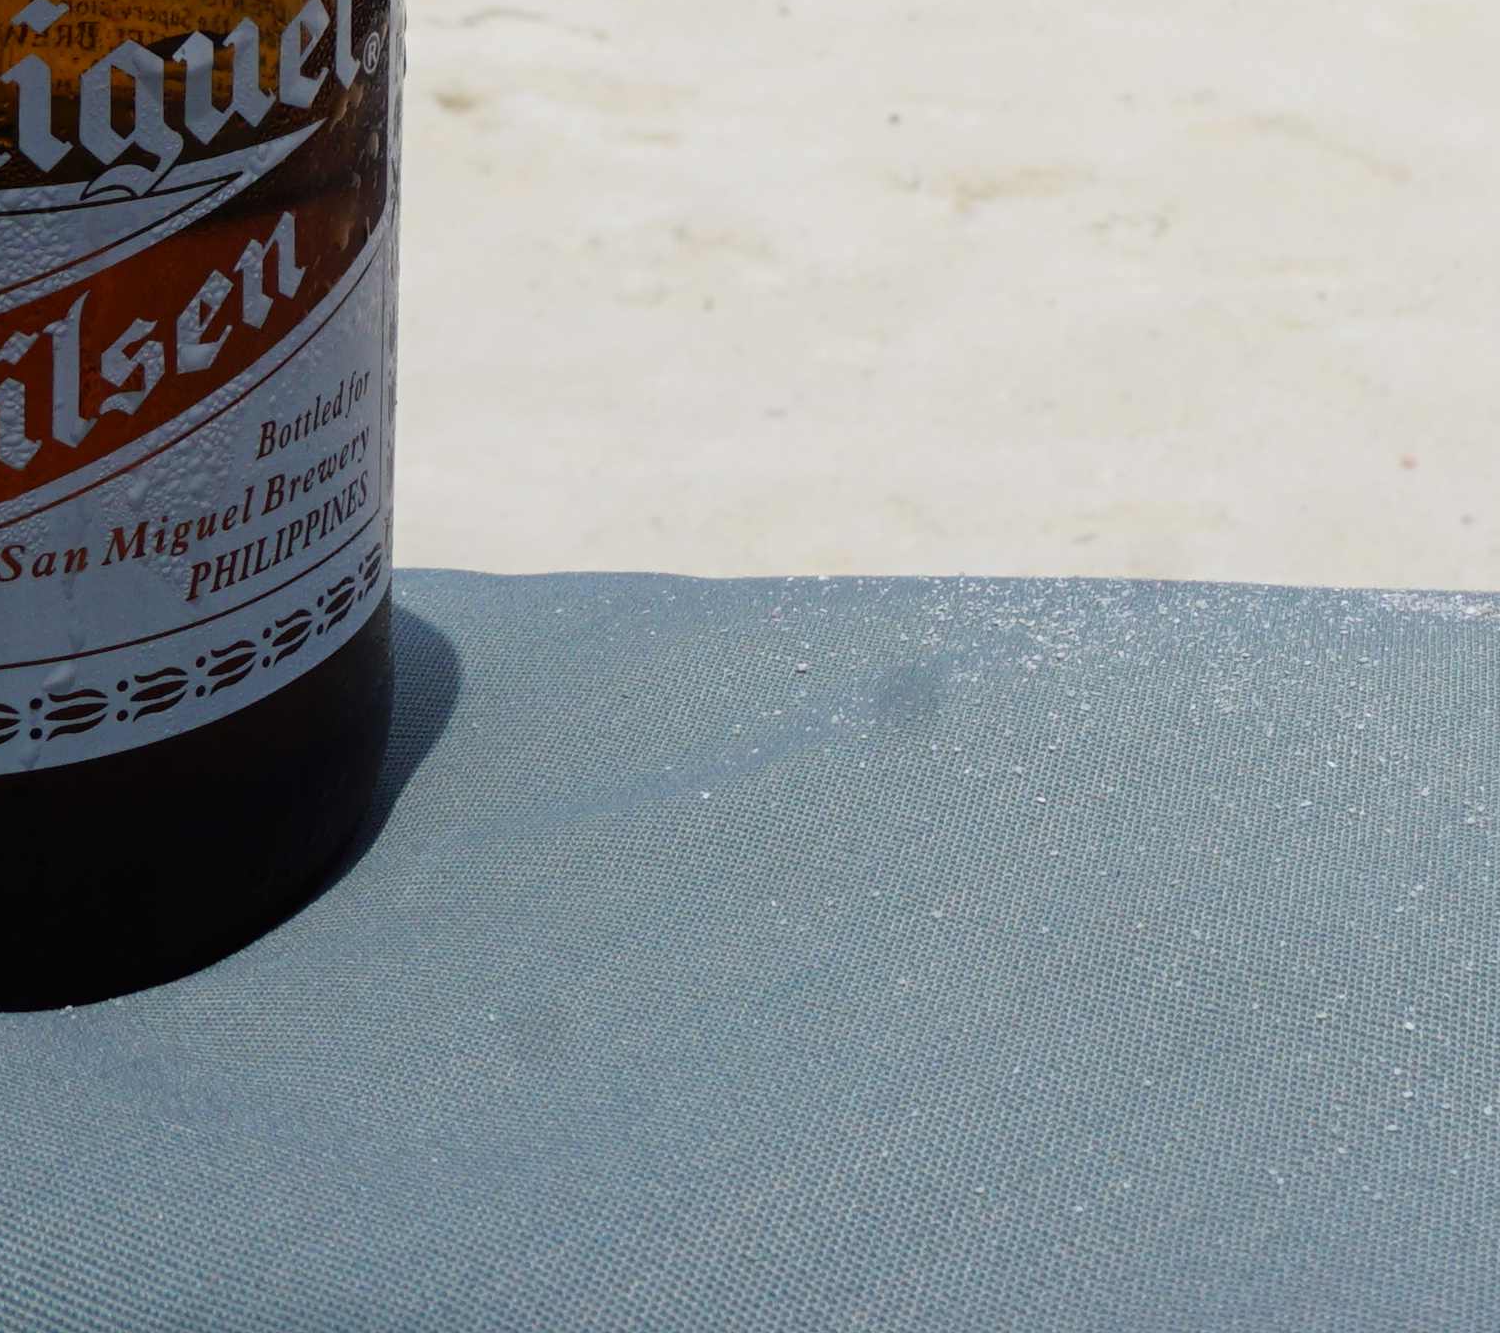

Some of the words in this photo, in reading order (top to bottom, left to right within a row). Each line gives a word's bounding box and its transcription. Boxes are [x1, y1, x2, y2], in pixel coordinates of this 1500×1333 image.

[255, 378, 345, 460] Bottled
[342, 369, 371, 419] for
[101, 486, 254, 568] Miguel
[260, 425, 371, 517] Brewery
[184, 469, 370, 602] PHILIPPINES
